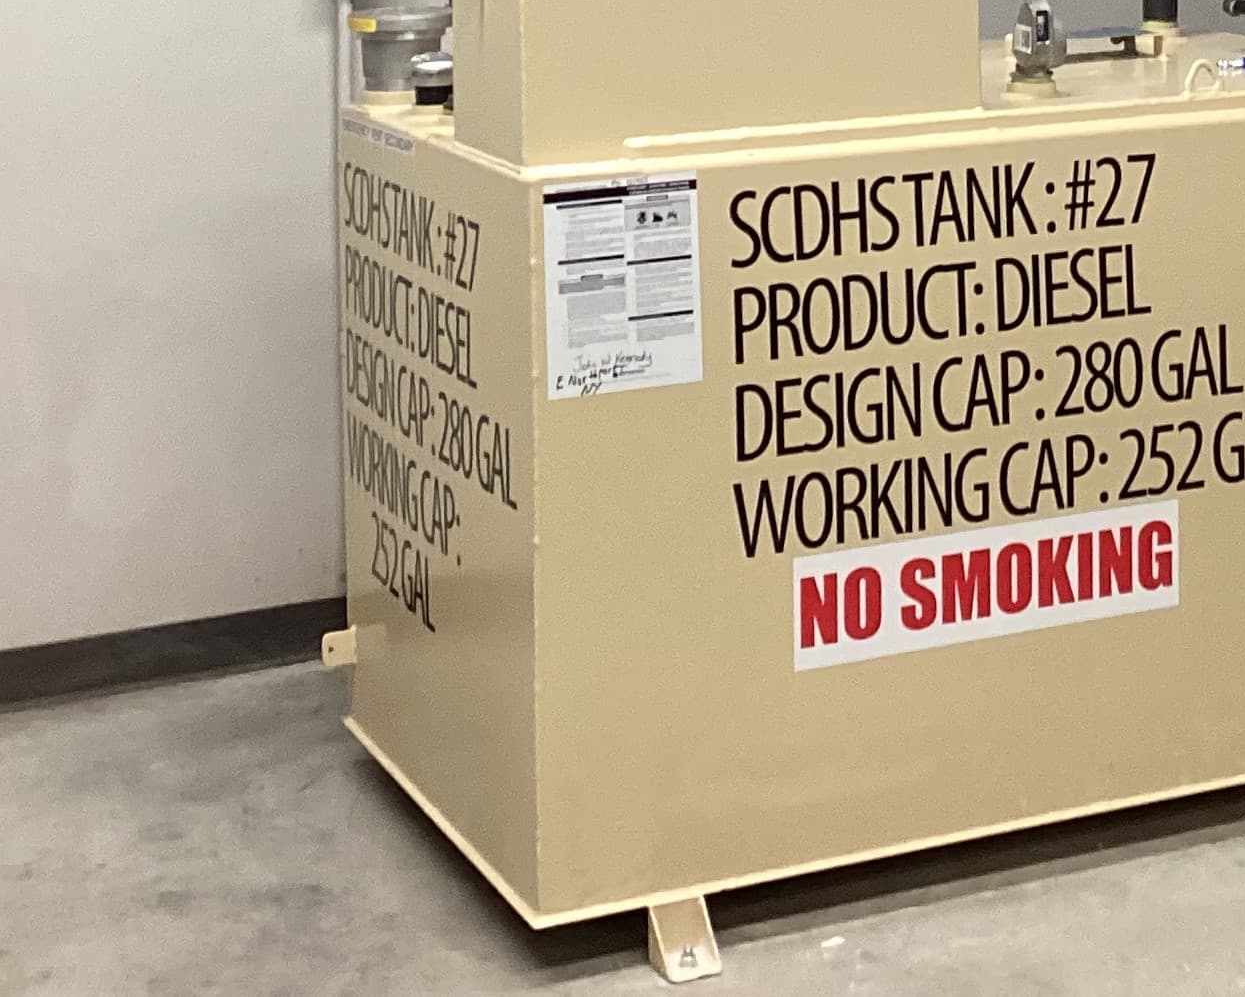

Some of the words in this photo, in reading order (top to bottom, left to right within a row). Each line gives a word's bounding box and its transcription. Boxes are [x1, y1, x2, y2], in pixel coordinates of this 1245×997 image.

[344, 162, 390, 249] SCDHS
[730, 176, 900, 268] SCDHS
[1064, 154, 1156, 231] #27
[345, 244, 416, 353] PRODUCT:
[418, 286, 478, 390] DIESEL
[734, 262, 985, 365] PRODUCT:
[995, 244, 1152, 332] DIESEL
[345, 327, 395, 427] DESIGN
[397, 365, 436, 457] CAP:
[438, 391, 474, 480] 280
[475, 414, 519, 512] GAL
[580, 381, 603, 397] NY
[736, 363, 922, 462] DESIGN
[932, 350, 1046, 432] CAP:
[1055, 338, 1144, 418] 280
[1151, 324, 1244, 403] GAL
[346, 409, 419, 533] WORKING
[733, 448, 990, 559] WORKING
[999, 434, 1109, 517] CAP:
[1118, 421, 1206, 501] 252
[371, 510, 400, 599] 252
[402, 539, 436, 634] GAL
[800, 567, 883, 648] NO
[900, 521, 1173, 630] SMOKING
